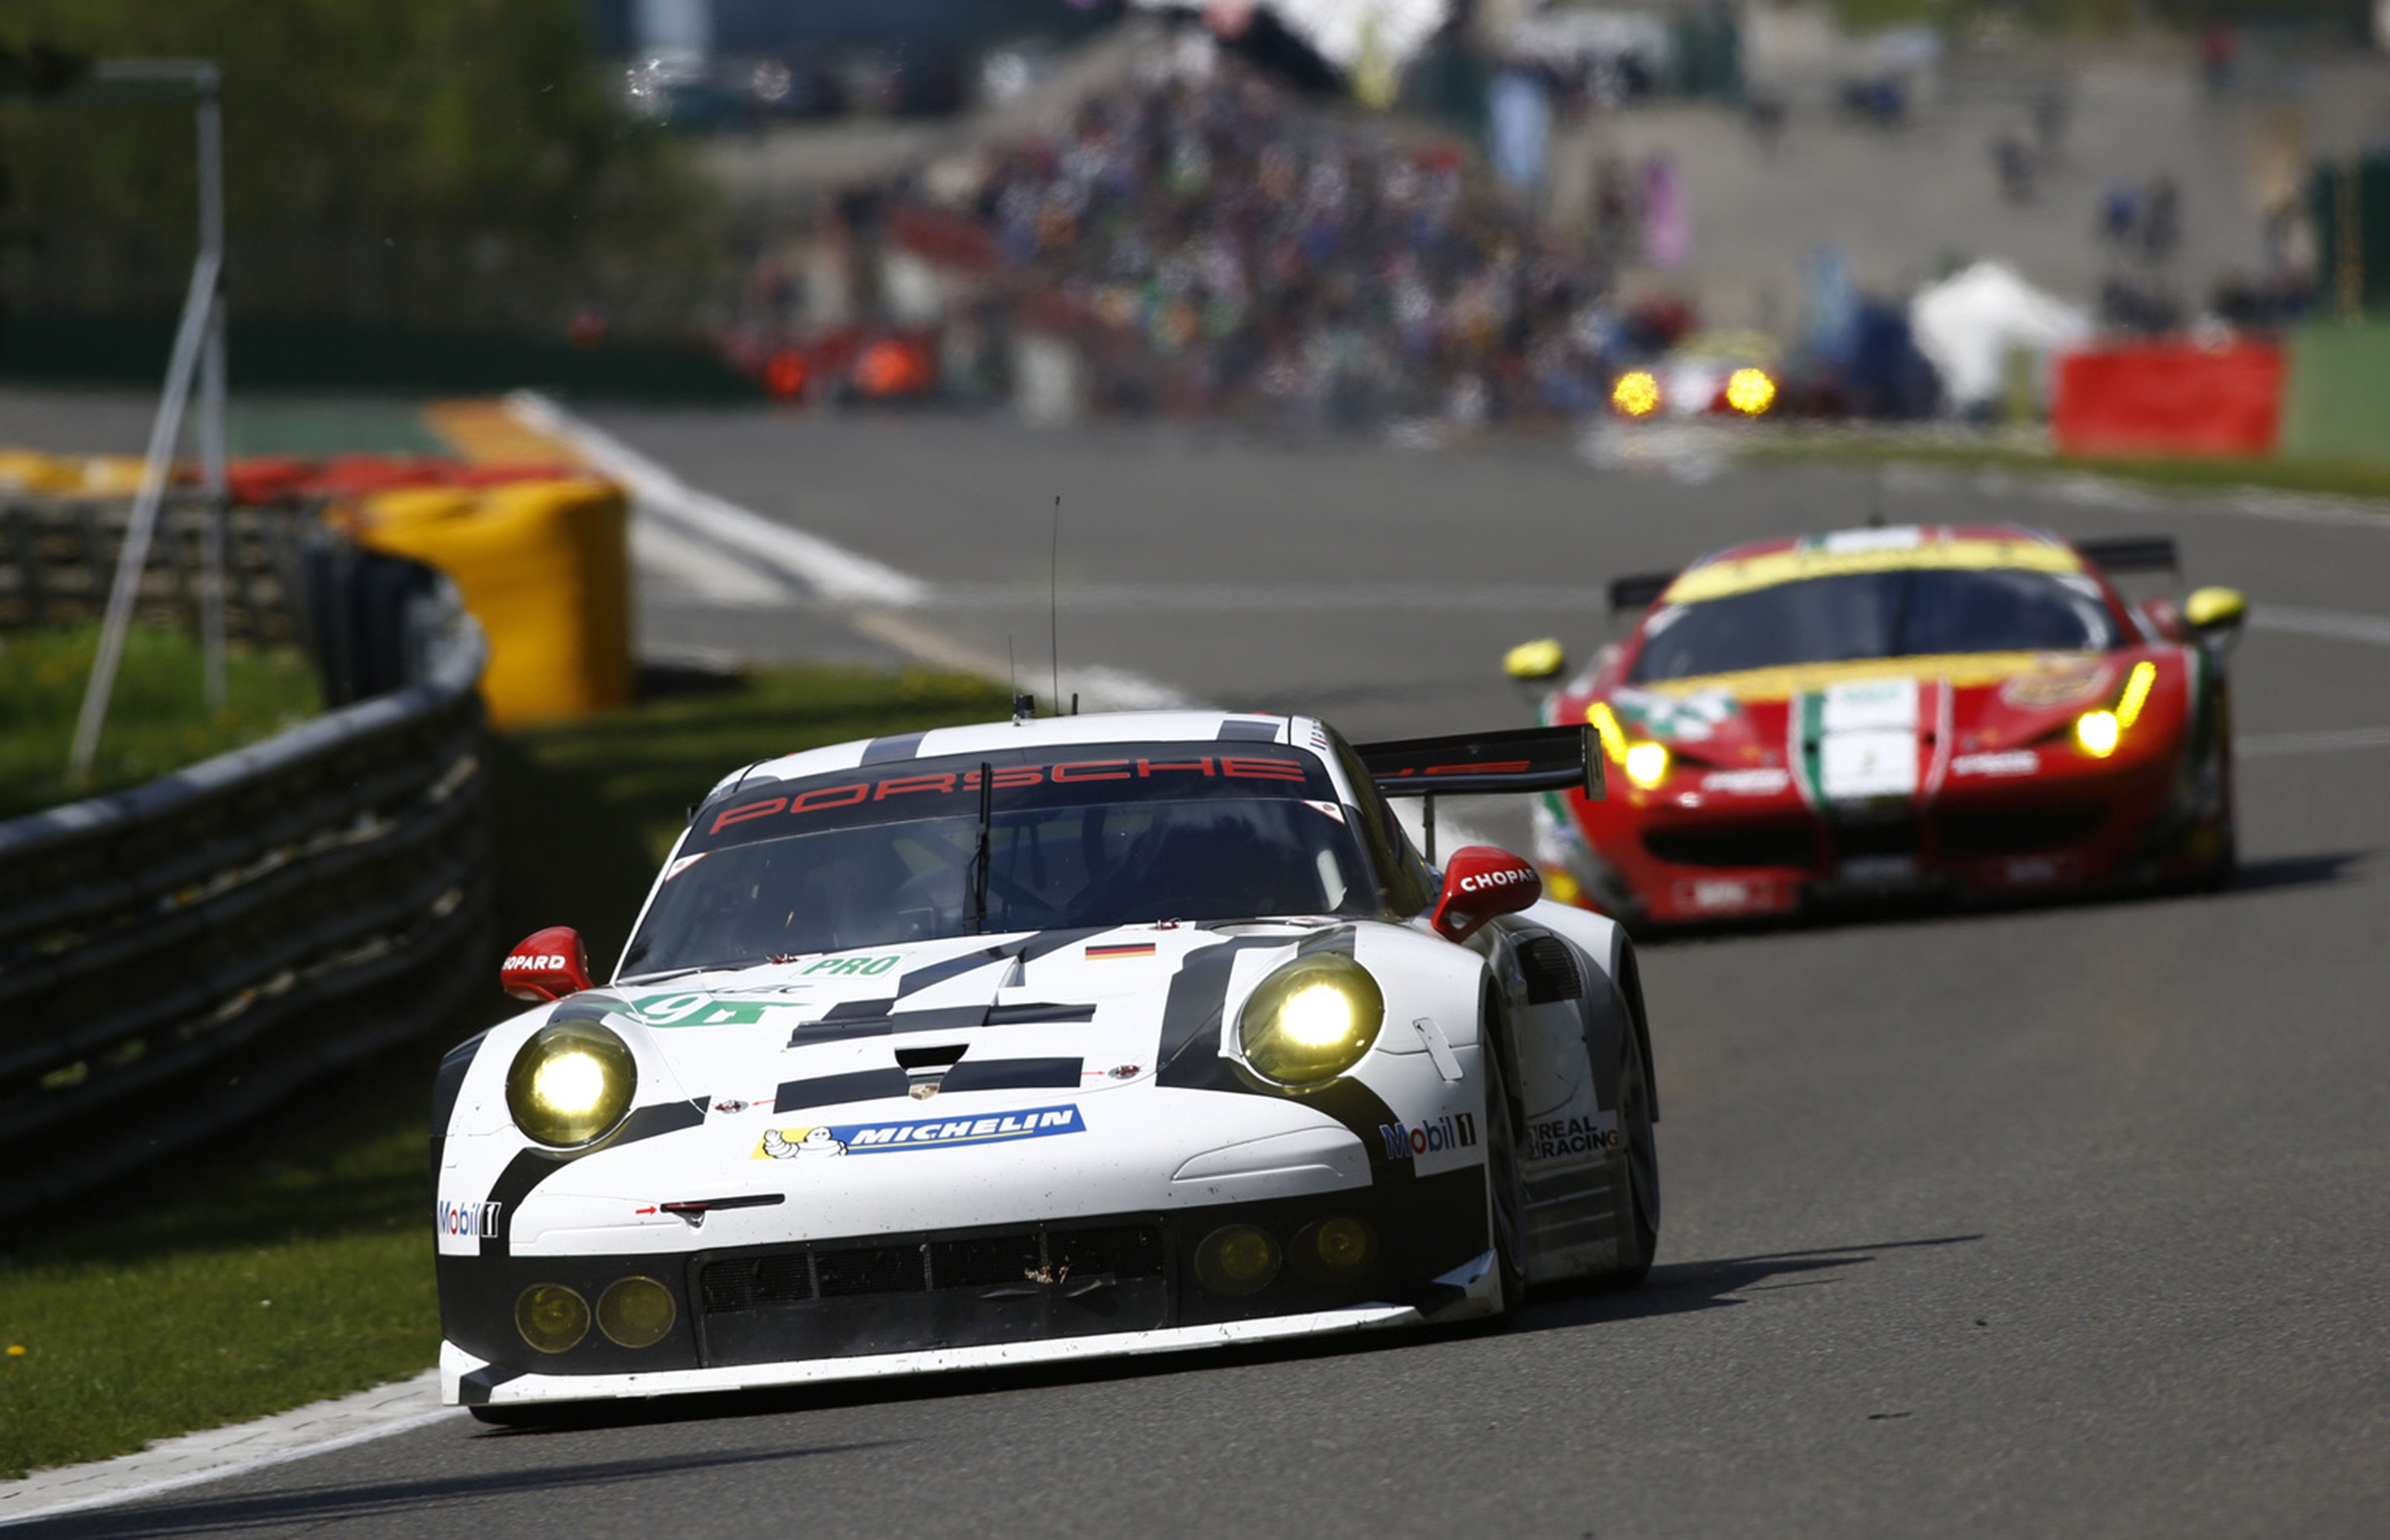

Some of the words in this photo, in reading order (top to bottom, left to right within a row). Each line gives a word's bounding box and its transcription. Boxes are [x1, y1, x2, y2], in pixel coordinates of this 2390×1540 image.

[710, 757, 1307, 836] PORSCHE
[801, 955, 901, 975] PRO
[850, 1109, 1074, 1145] MICHELIN
[1380, 1116, 1456, 1159] Mobil
[1457, 1113, 1475, 1147] 1
[1539, 1116, 1597, 1140] REAL
[1542, 1129, 1619, 1158] RACING
[439, 1200, 480, 1235] Mobil
